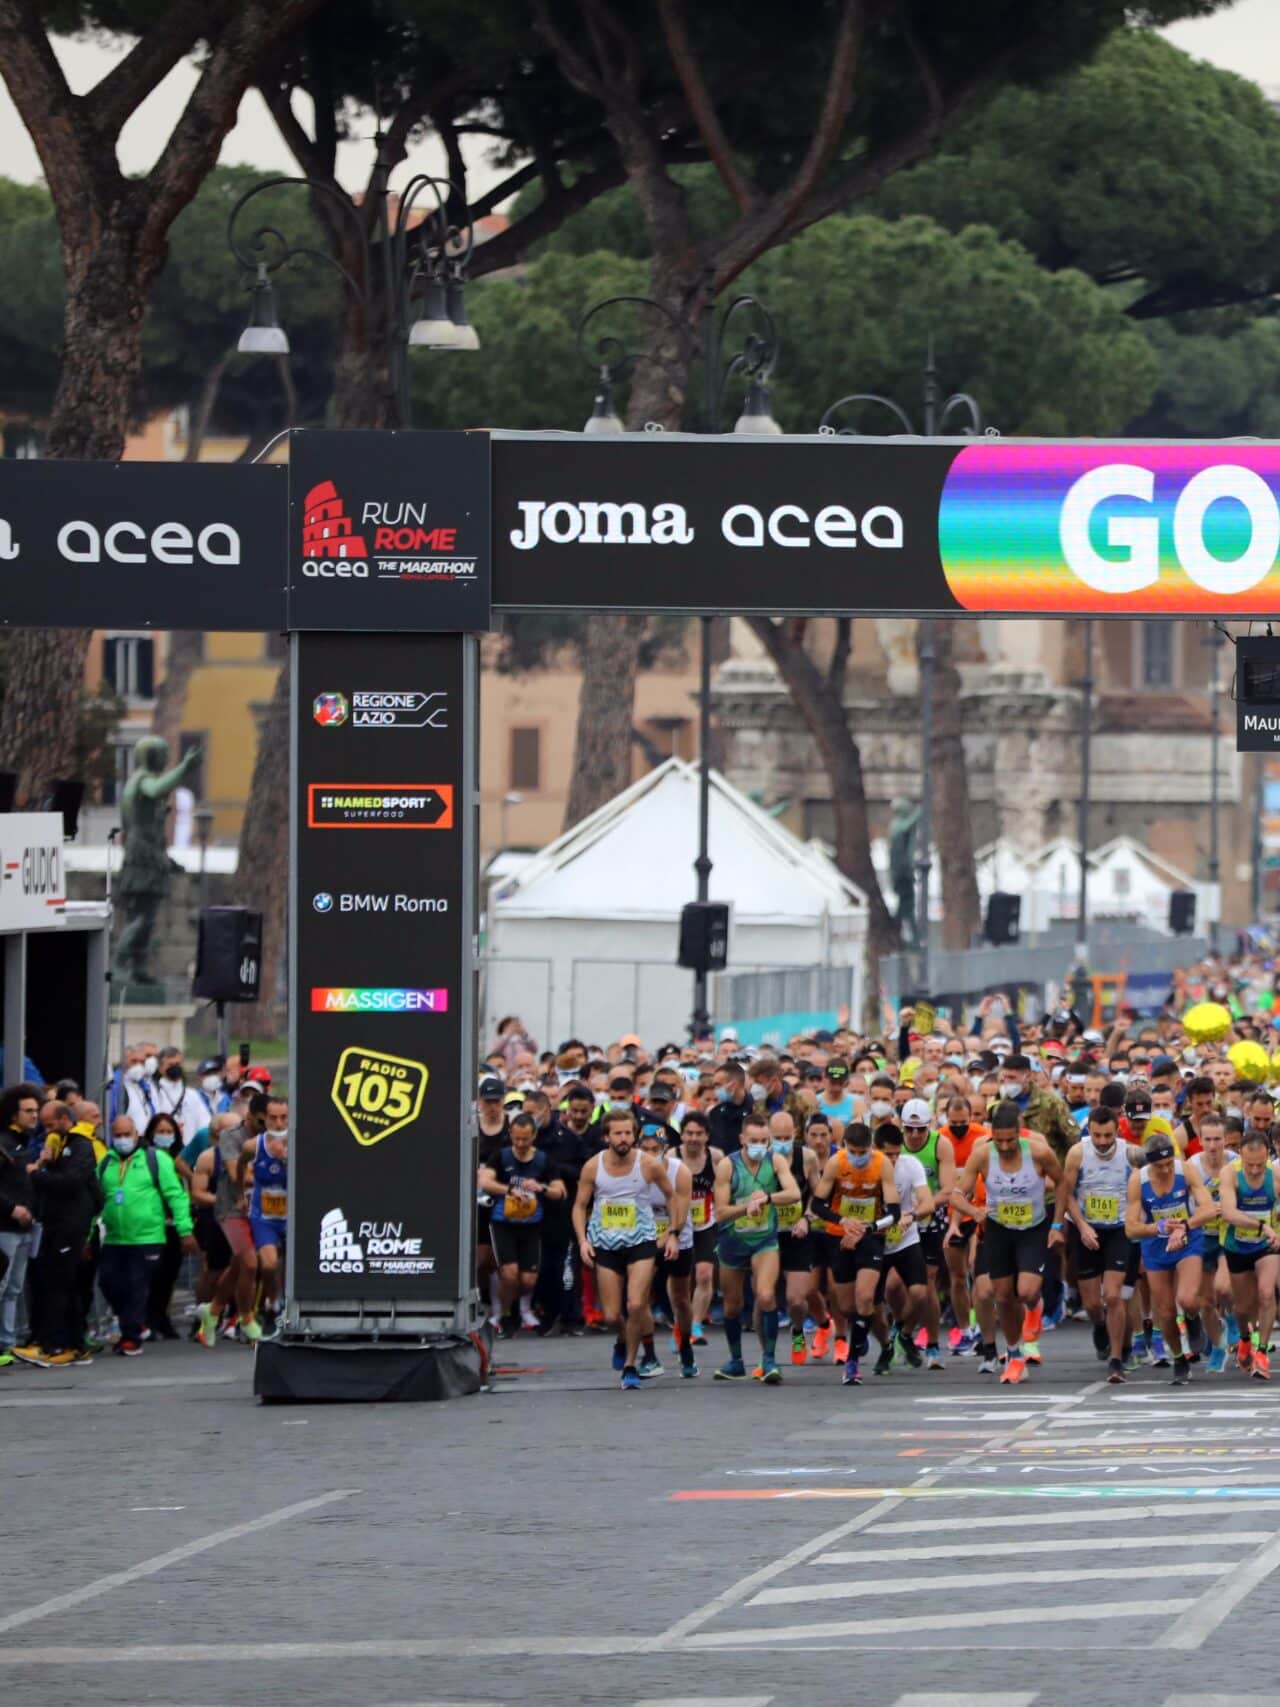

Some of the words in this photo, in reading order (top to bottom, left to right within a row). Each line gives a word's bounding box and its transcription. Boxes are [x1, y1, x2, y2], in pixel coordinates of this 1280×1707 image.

[361, 502, 428, 525] RUN
[721, 505, 904, 548] acea
[57, 520, 240, 565] acea
[374, 528, 457, 550] ROME
[302, 561, 369, 577] acea
[378, 561, 397, 571] THE
[399, 561, 475, 573] MARATHON
[353, 695, 415, 708] REGIONE
[353, 711, 396, 724] LAZIO
[339, 894, 390, 912] BMW
[394, 894, 448, 912] Roma
[325, 991, 435, 1009] MASSIGEN
[360, 1059, 408, 1079] RADIO
[343, 1071, 414, 1118] 105
[359, 1222, 403, 1238] RUN
[367, 1239, 423, 1255] ROME
[319, 1261, 364, 1273] acea
